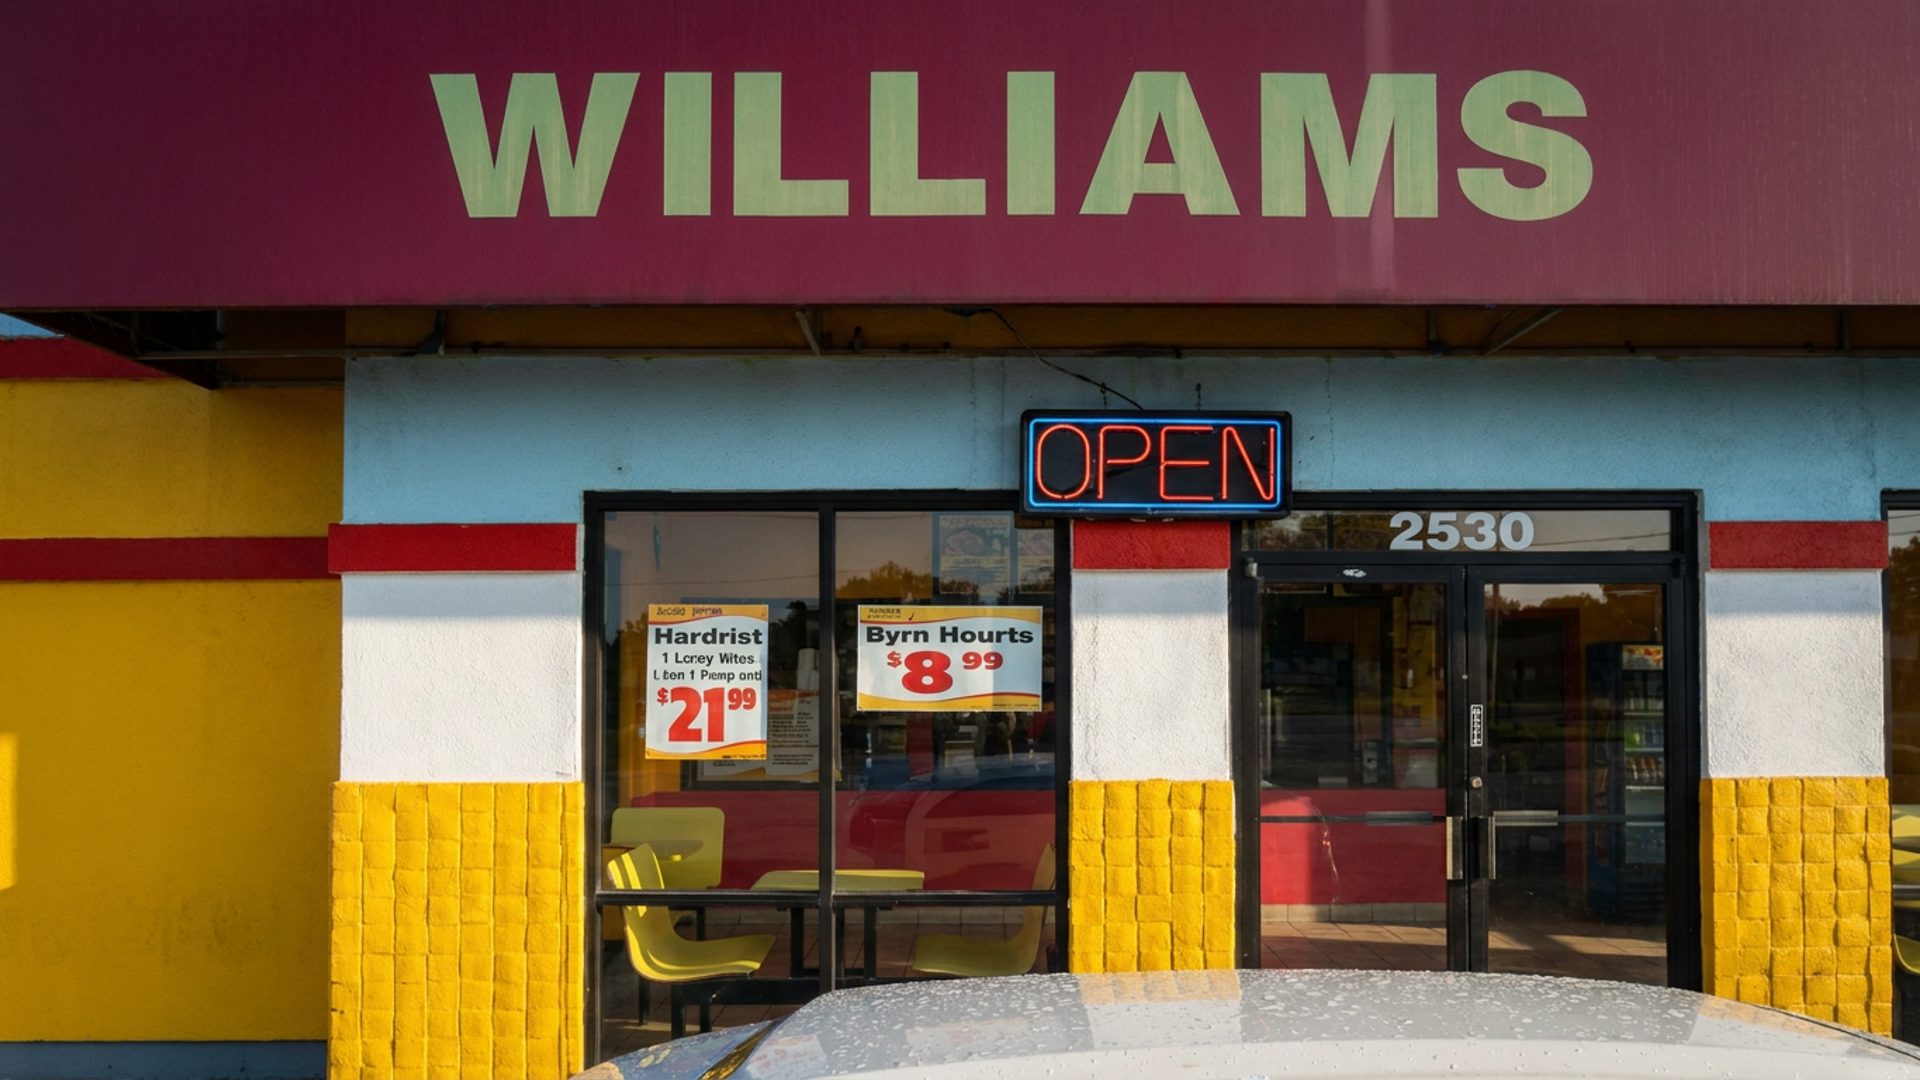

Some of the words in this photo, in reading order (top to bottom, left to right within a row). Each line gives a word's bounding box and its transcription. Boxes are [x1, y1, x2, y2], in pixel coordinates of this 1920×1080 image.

[429, 69, 1594, 222] WILLIAMS
[1036, 424, 1275, 500] OPEN
[1389, 511, 1535, 551] 2530
[655, 627, 763, 645] Hardrist
[866, 626, 929, 646] Byrn
[940, 626, 1034, 644] Hourts
[662, 652, 668, 663] 1
[690, 669, 695, 680] 1
